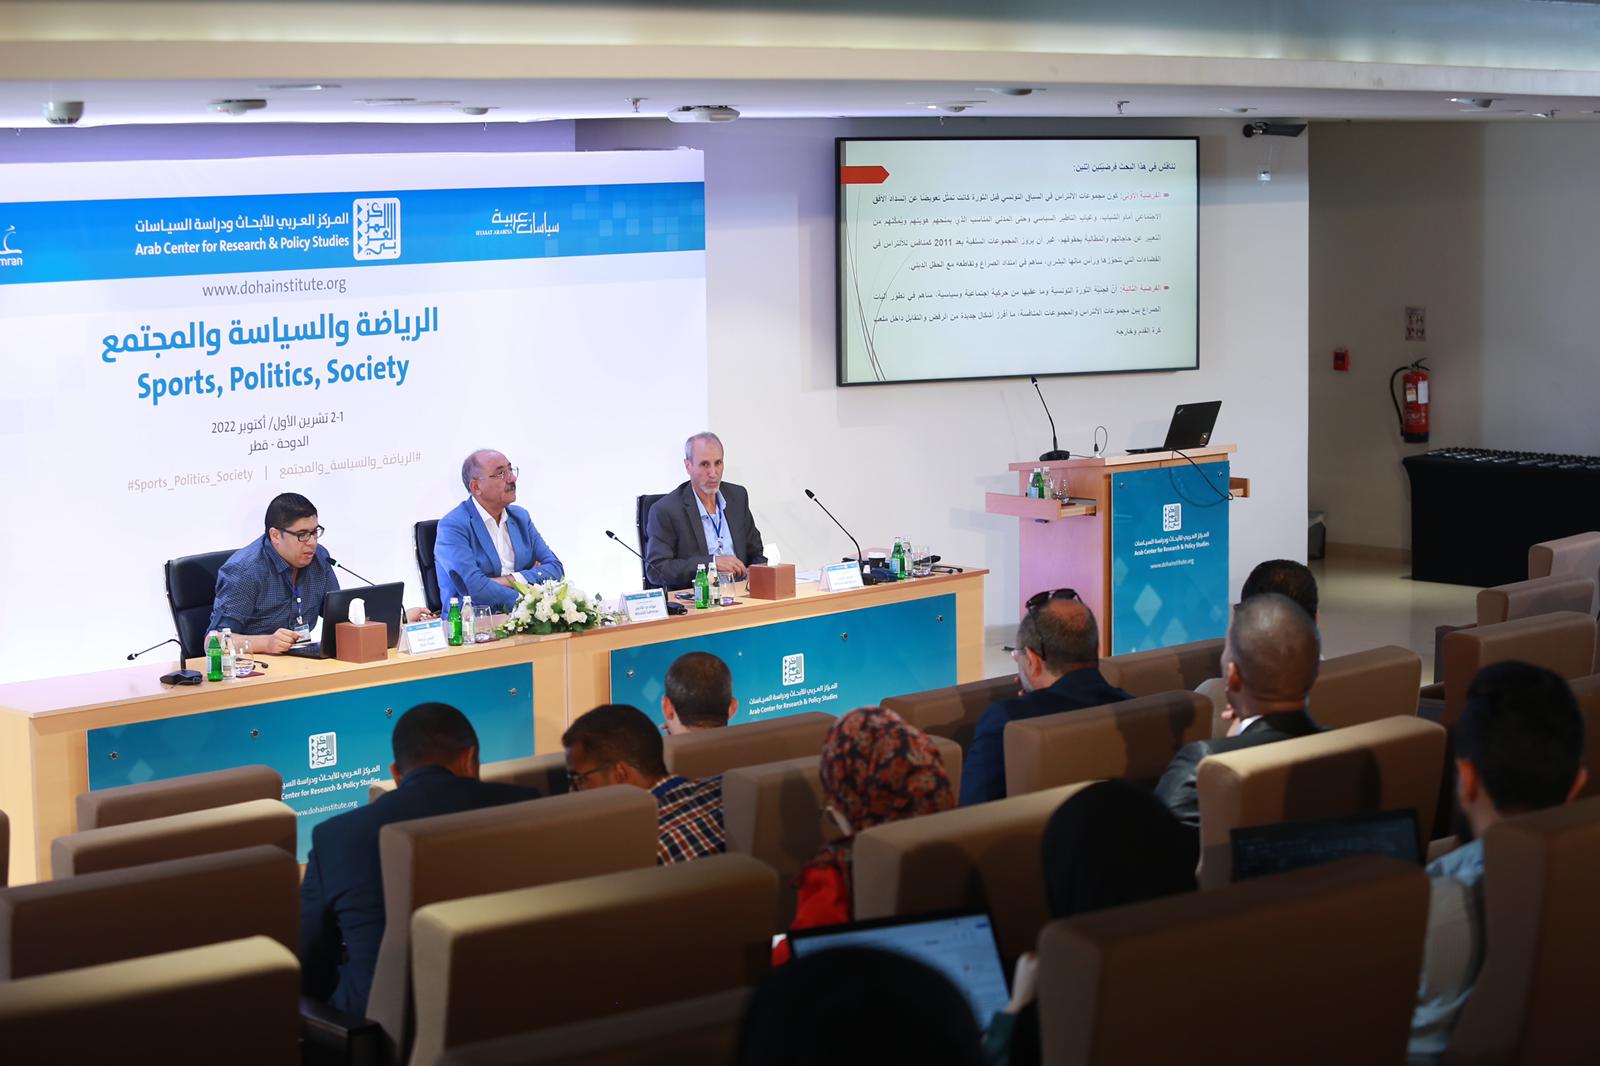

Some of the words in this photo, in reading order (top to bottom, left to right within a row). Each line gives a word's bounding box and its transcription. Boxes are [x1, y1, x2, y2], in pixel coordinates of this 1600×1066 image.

[1119, 163, 1136, 171] البحث
[135, 218, 192, 236] السياسات
[194, 219, 234, 235] ودراسة
[235, 216, 274, 234] للأبحاث
[276, 214, 314, 233] العربي
[316, 211, 349, 229] المركز
[134, 242, 162, 256] Arab
[164, 239, 200, 254] Center
[202, 238, 217, 252] for
[219, 235, 266, 251] Research
[268, 237, 278, 249] &
[280, 233, 310, 251] Policy
[312, 233, 350, 248] Studies
[934, 238, 952, 248] 2011
[202, 279, 347, 298] www.dohainstitute.org
[228, 313, 350, 350] والسياسة
[356, 306, 438, 342] الرياضة
[102, 321, 220, 362] والمجتمع
[137, 369, 224, 406] Sports,
[230, 361, 320, 396] Politics,
[328, 355, 410, 391] Society
[211, 423, 236, 436] 2022
[238, 420, 266, 439] أكتوبر
[300, 413, 328, 432] تشرين
[248, 441, 268, 458] قطر
[276, 436, 310, 450] الدوحة
[128, 469, 254, 492] #Sports_Politics_Society
[761, 705, 776, 713] Center
[783, 701, 803, 709] Research
[808, 697, 822, 706] Policy
[822, 694, 838, 702] Studies
[281, 791, 300, 800] Center
[301, 789, 310, 797] for
[310, 785, 336, 795] Research
[342, 780, 360, 791] Policy
[360, 778, 381, 787] Studies
